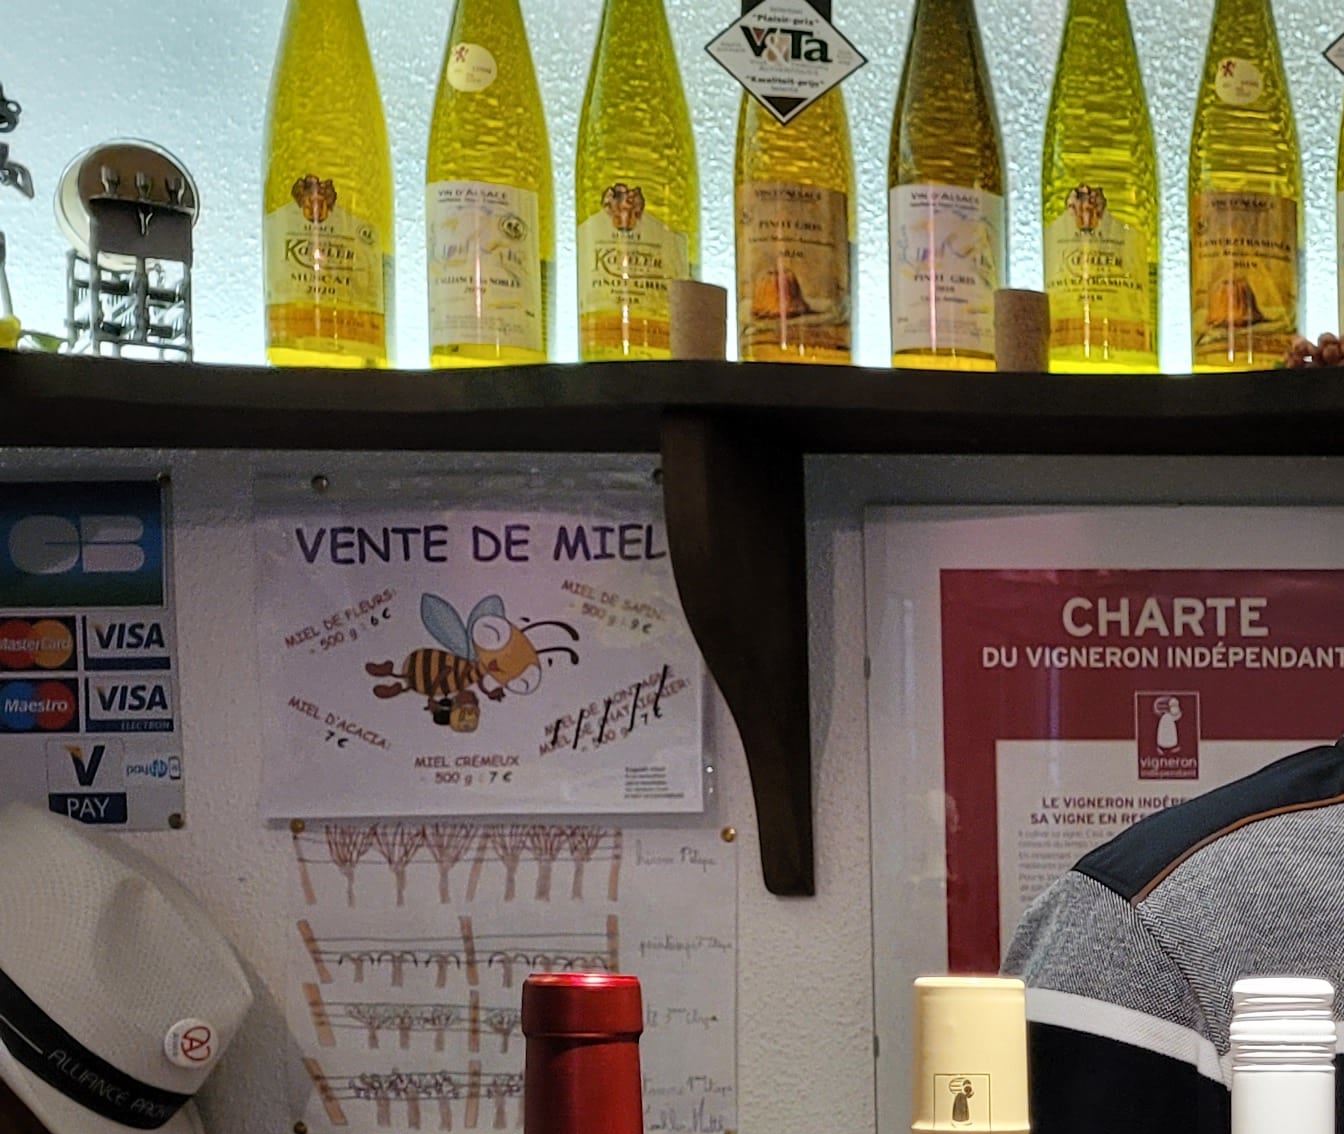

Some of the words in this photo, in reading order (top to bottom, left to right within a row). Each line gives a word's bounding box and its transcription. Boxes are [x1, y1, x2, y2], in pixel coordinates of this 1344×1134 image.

[296, 525, 448, 565] VENTE
[472, 525, 530, 562] DE
[554, 525, 666, 560] MIEL
[562, 580, 596, 599] MIEL
[600, 592, 619, 605] DE
[1061, 596, 1269, 637] CHARTE
[95, 623, 165, 649] VISA
[285, 625, 320, 648] MIEL
[323, 616, 344, 631] DE
[982, 647, 1021, 669] DU
[1025, 646, 1160, 670] VIGNERON
[4, 699, 68, 713] Maestro
[98, 685, 168, 711] VISA
[288, 696, 320, 720] MIEL
[121, 719, 170, 730] ELECTRON
[415, 756, 452, 768] MIEL
[1140, 757, 1197, 770] vigneron
[435, 771, 459, 783] 500
[67, 798, 109, 818] PAY
[1042, 797, 1058, 809] LE
[1064, 797, 1134, 809] VIGNERON
[1031, 814, 1048, 825] SA
[1053, 813, 1094, 824] VIGNE
[1100, 813, 1117, 824] EN
[48, 1050, 129, 1105] ALLIANCE
